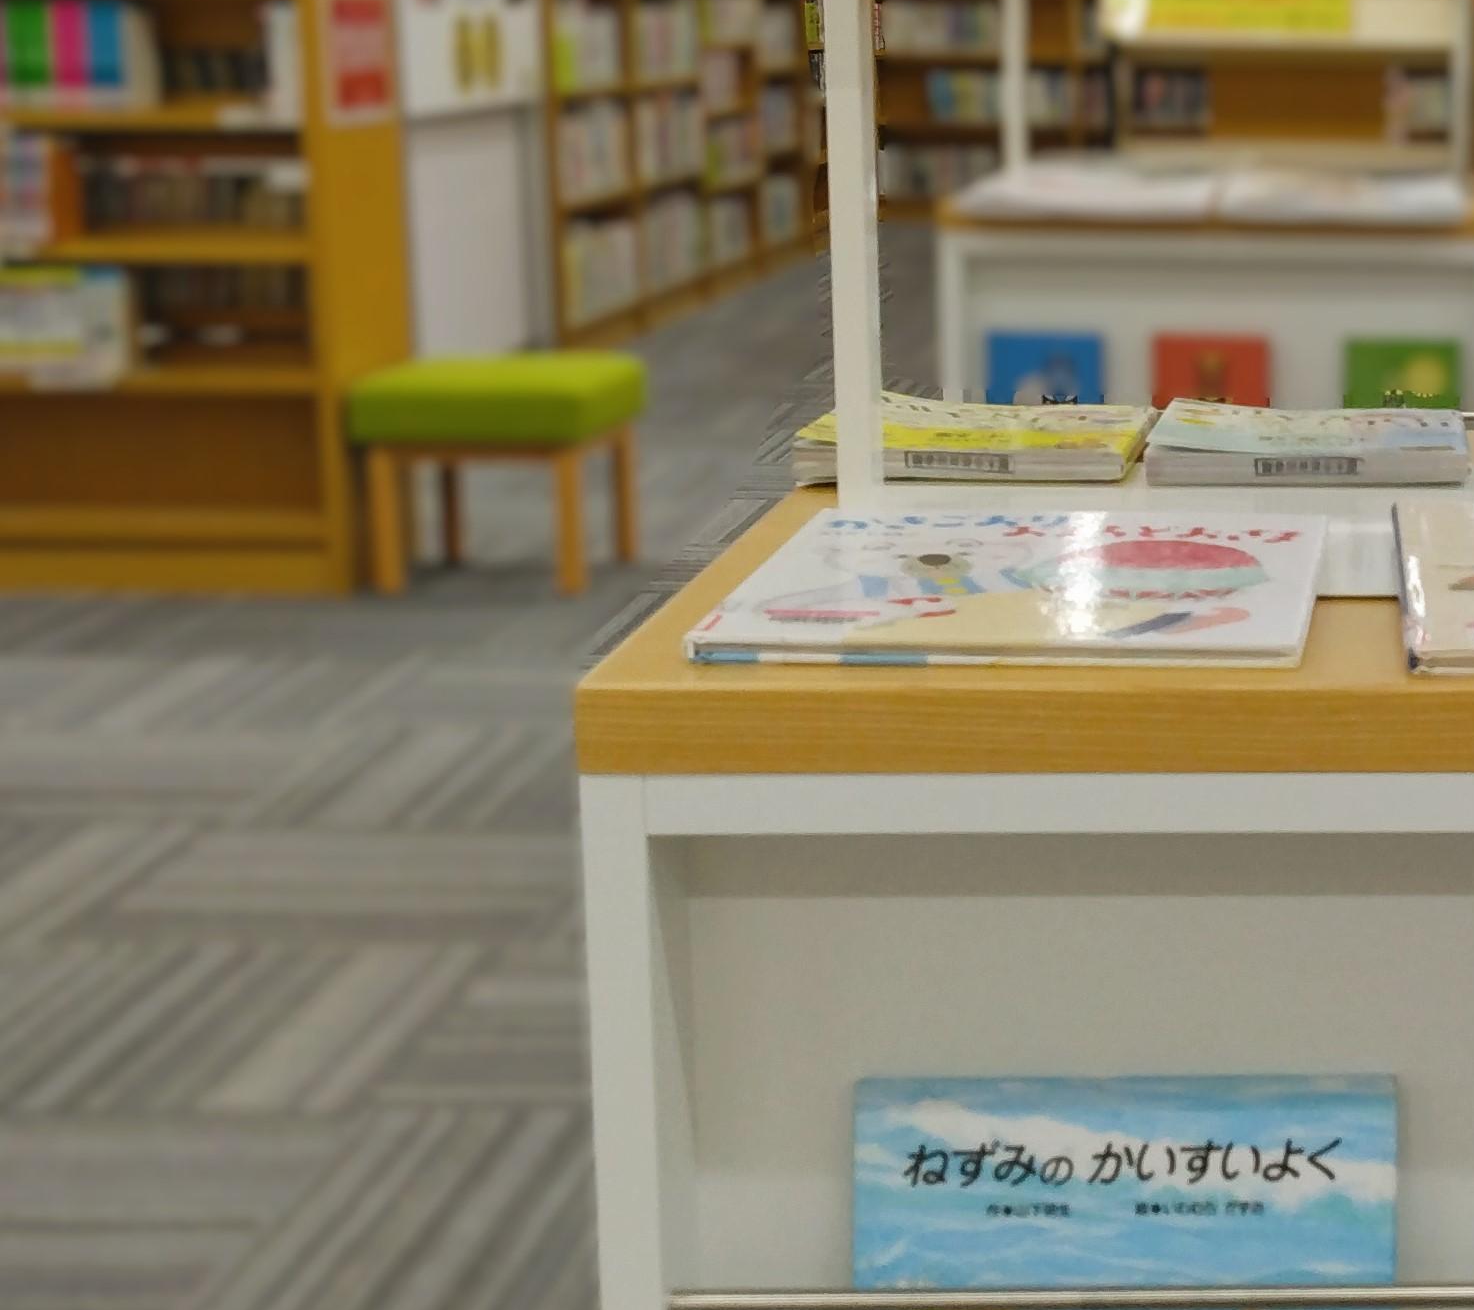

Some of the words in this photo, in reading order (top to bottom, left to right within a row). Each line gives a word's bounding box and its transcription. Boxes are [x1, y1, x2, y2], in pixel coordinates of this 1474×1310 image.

[902, 1142, 1075, 1188] ねずみの
[1087, 1136, 1343, 1187] かいすいよく
